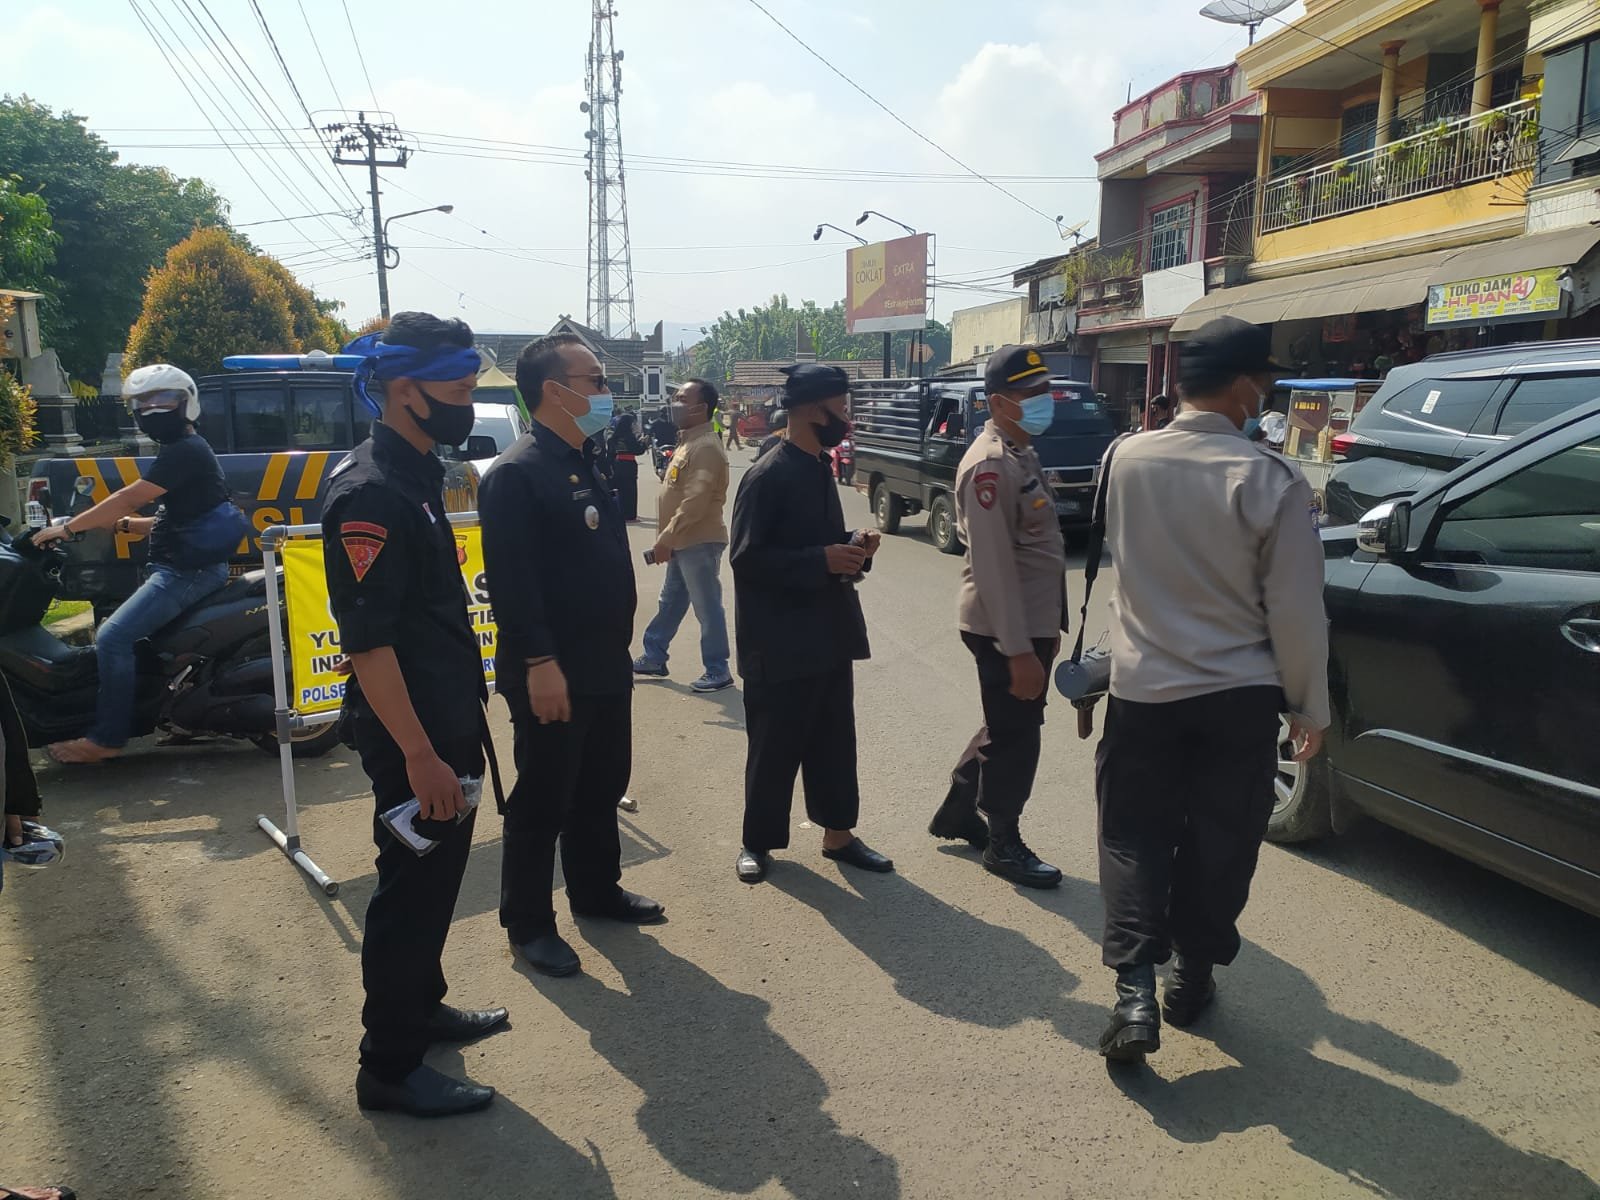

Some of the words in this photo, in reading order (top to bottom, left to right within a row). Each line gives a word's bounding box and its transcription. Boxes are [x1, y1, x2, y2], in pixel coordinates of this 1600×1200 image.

[856, 267, 883, 284] COKLAT
[1450, 282, 1480, 297] TOKO
[1483, 278, 1512, 293] JAM
[1467, 290, 1511, 306] PIAN
[310, 631, 341, 649] YU
[302, 682, 346, 704] POLSE
